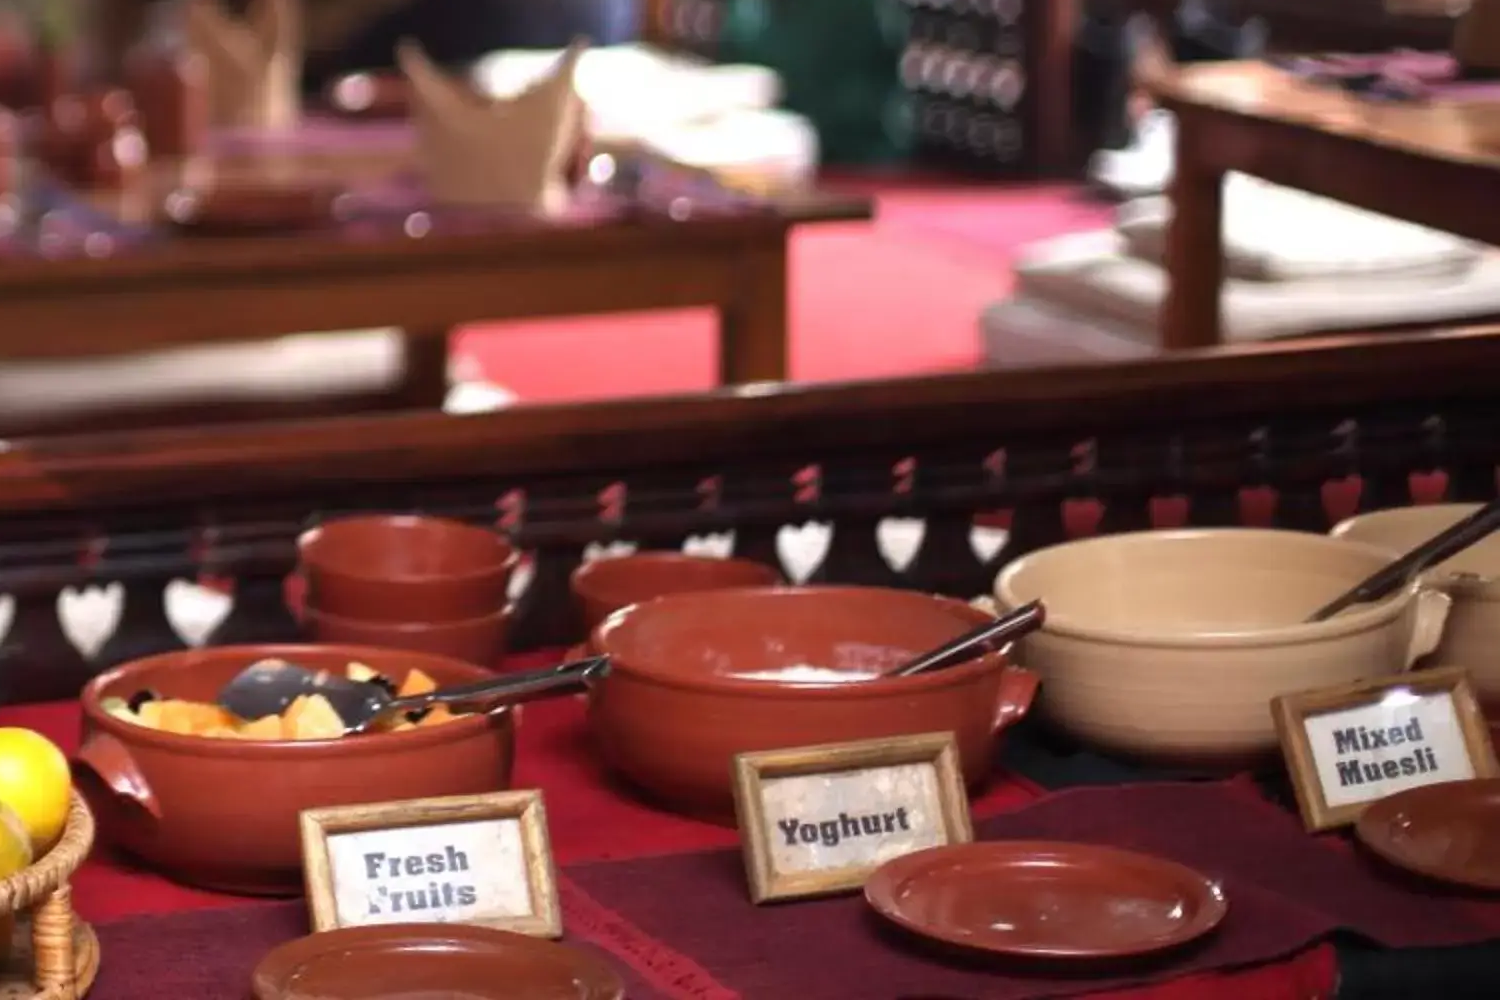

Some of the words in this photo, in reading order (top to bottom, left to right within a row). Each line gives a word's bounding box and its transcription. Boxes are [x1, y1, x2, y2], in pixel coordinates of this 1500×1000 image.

[1332, 716, 1424, 755] Mixed
[1335, 746, 1439, 787] Muesli
[777, 806, 910, 847] Yoghurt
[363, 845, 470, 879] Fresh
